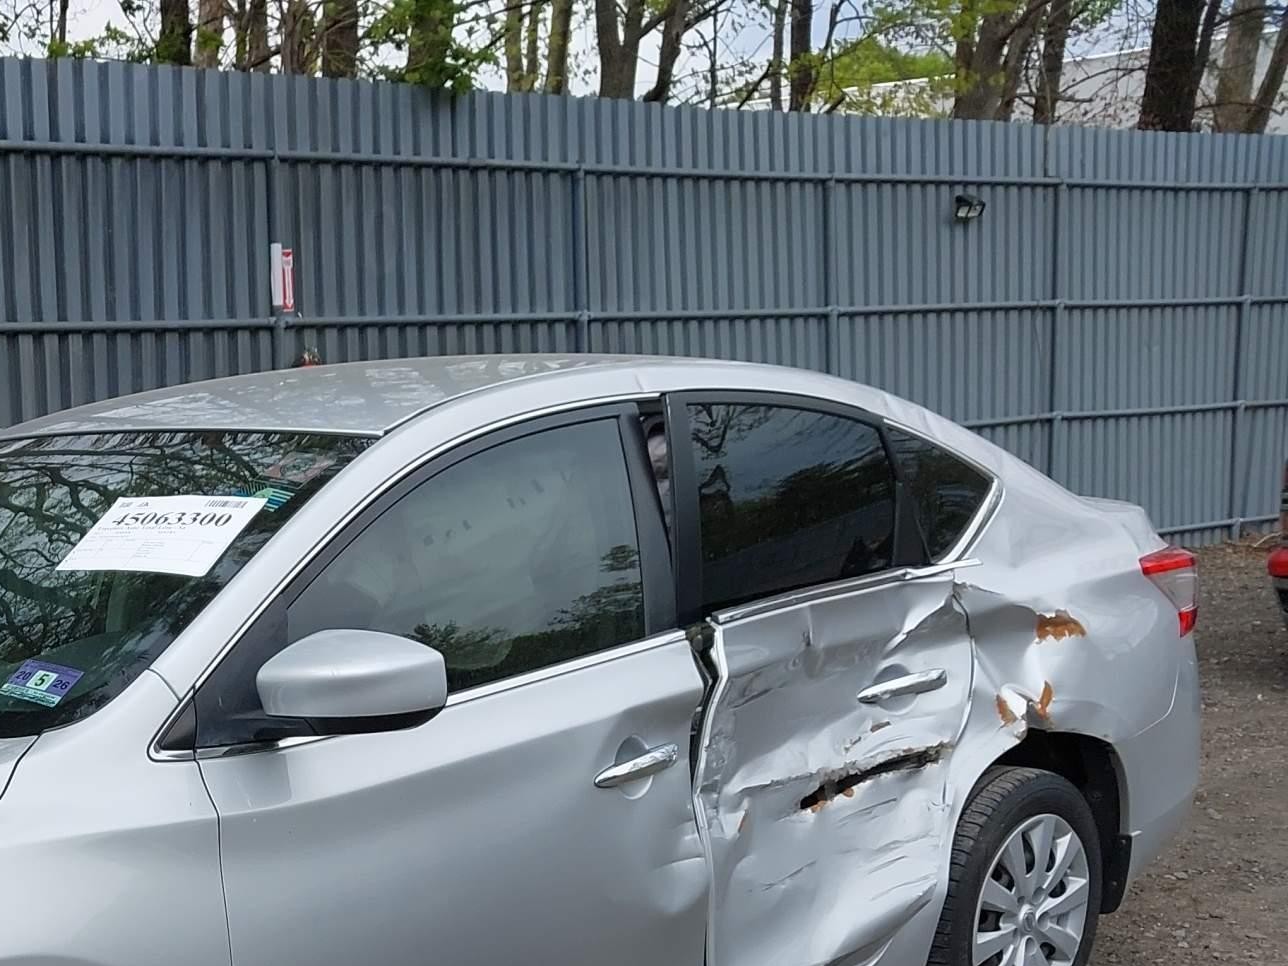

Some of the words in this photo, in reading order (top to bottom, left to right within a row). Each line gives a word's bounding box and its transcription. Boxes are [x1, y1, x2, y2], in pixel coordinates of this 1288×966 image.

[112, 511, 232, 526] 45063300
[16, 670, 32, 681] 20
[34, 673, 50, 687] 5
[53, 679, 71, 690] 26
